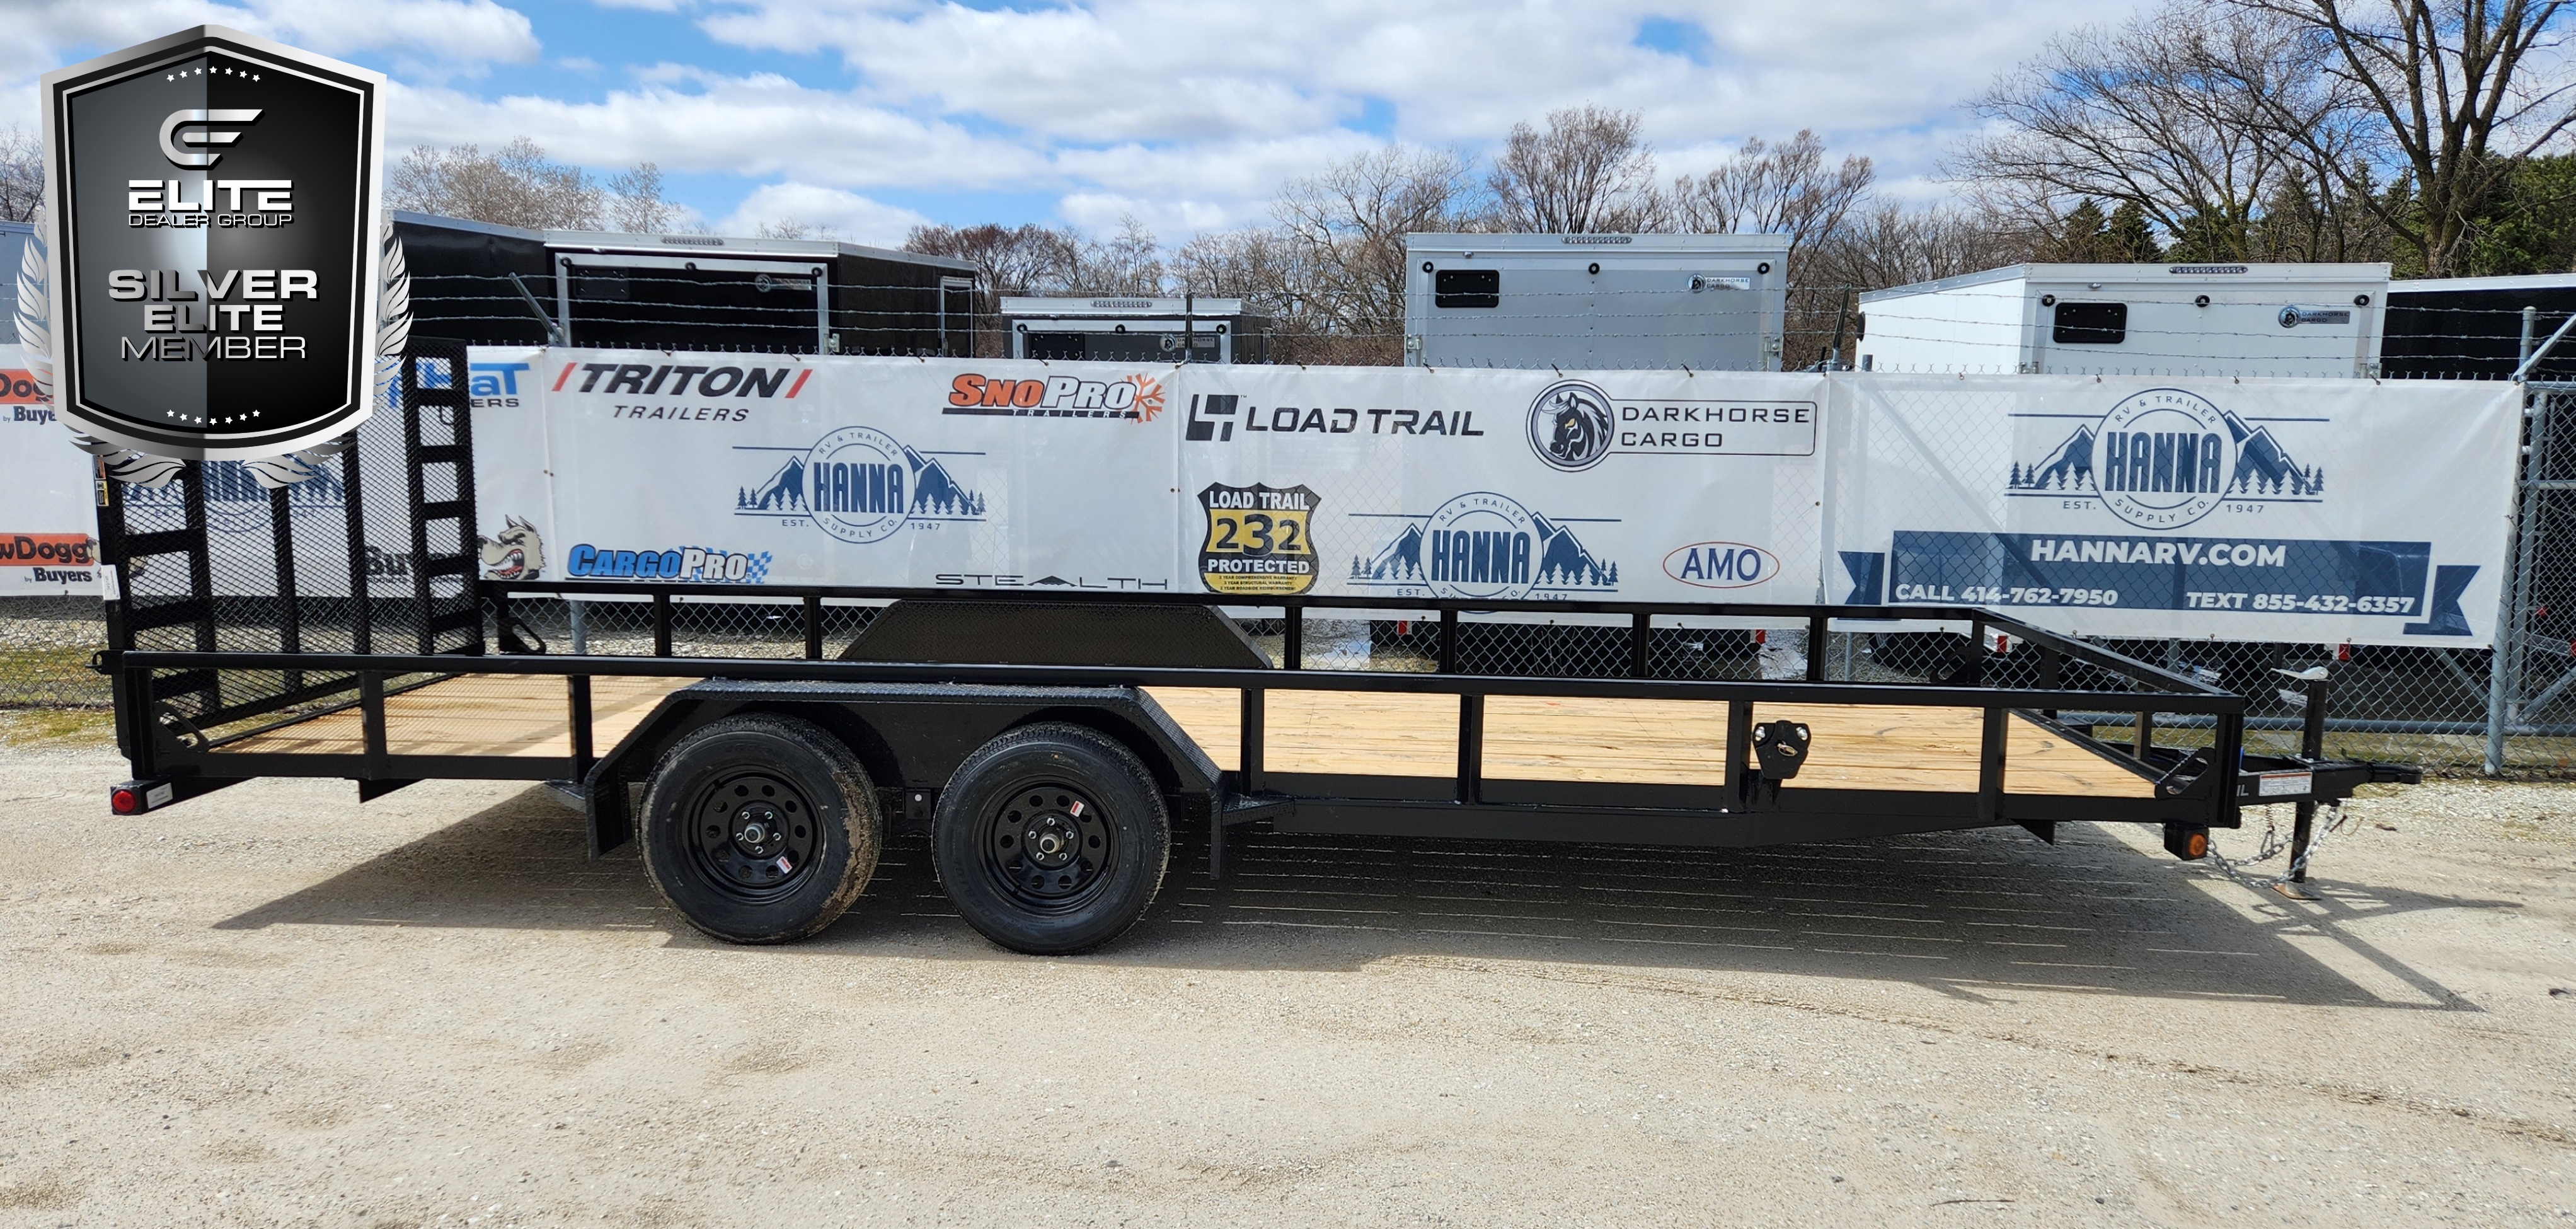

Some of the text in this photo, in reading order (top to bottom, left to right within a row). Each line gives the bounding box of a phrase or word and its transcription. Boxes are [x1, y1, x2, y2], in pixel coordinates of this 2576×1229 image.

[578, 362, 791, 398] TRITON
[613, 405, 749, 422] TRAILERS
[1012, 408, 1127, 418] TRAILERS
[1622, 407, 1810, 424] DARKHORSE
[2114, 395, 2217, 424] RV & TRAILER
[1245, 406, 1485, 437] LOAD TRAIL
[819, 441, 832, 455] RV
[849, 432, 899, 456] TRAILER
[1621, 432, 1723, 447] CARGO
[2104, 431, 2222, 493] HANNA
[813, 461, 904, 514] HANNA
[1209, 490, 1310, 511] LOAD TRAIL
[1439, 508, 1453, 522] RV
[1473, 498, 1526, 524] TRAILER
[2063, 500, 2265, 514] EST. 1947
[2115, 499, 2209, 523] SUPPLY CO.
[781, 518, 941, 531] EST. 1947
[822, 517, 898, 538] SUPPLY CO.
[1216, 513, 1302, 557] 232
[1430, 529, 1531, 584] HANNA
[2030, 538, 2287, 567] HANNARV.COM
[33, 567, 93, 585] Buyers
[1207, 558, 1310, 574] PROTECTED
[1680, 548, 1762, 581] AMO
[1396, 588, 1425, 596] EST.
[1894, 583, 2119, 606] CALL 414-762-7950
[2185, 591, 2415, 614] TEXT 855-432-6357
